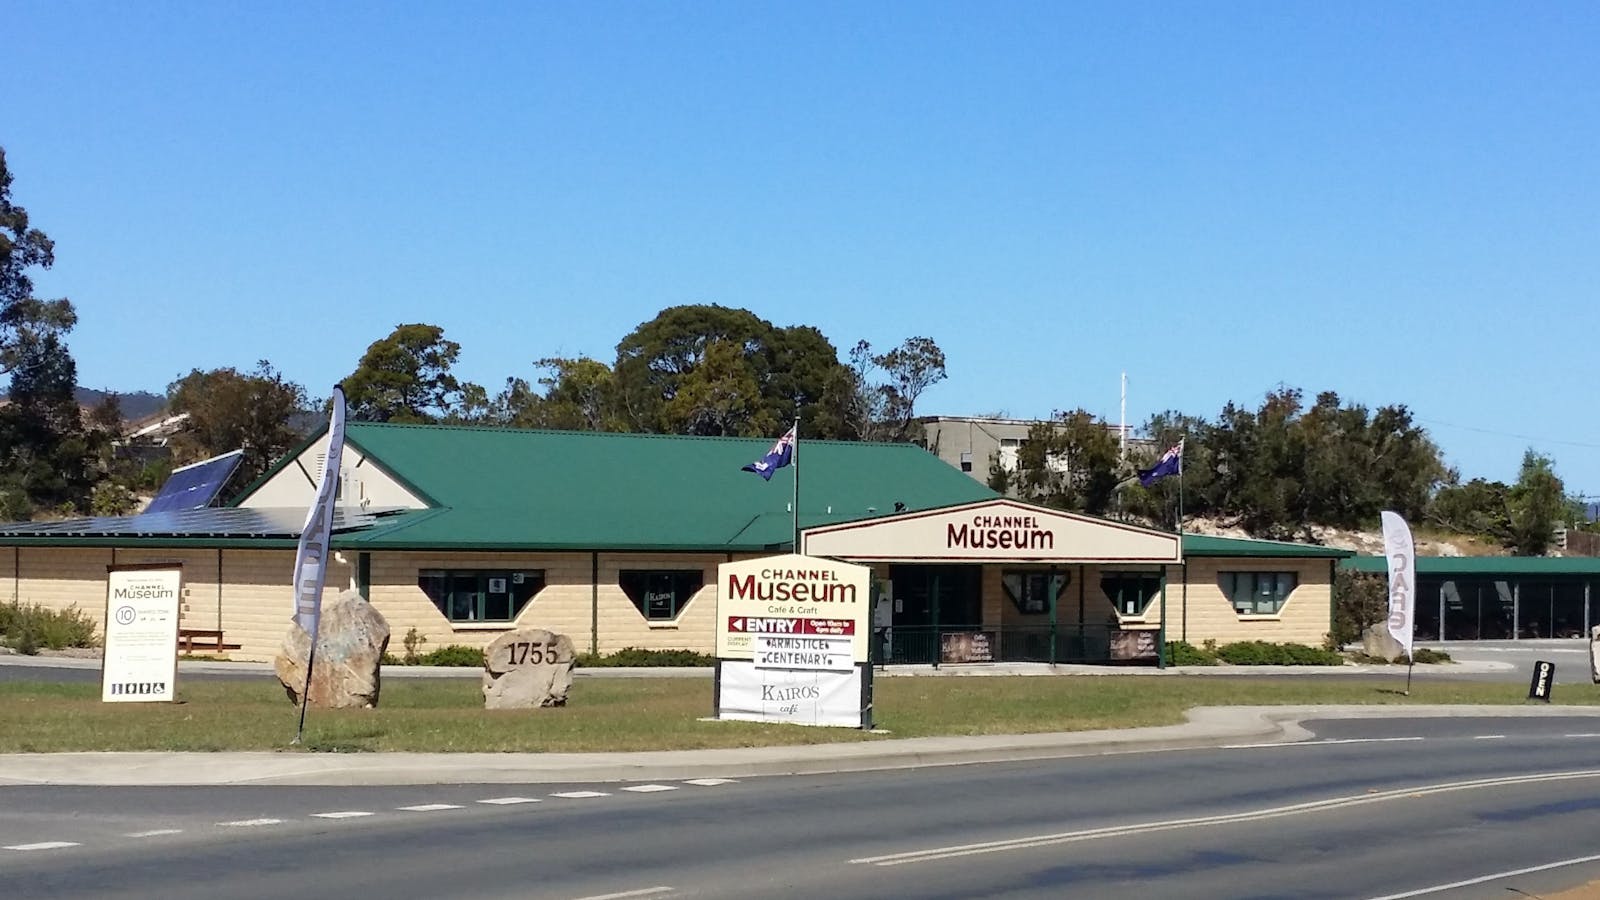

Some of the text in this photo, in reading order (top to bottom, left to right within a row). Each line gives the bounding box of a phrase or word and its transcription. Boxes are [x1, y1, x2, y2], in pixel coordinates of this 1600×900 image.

[973, 516, 1039, 528] CHANNEL
[947, 523, 1053, 549] Museum
[761, 569, 839, 581] CHANNEL
[115, 588, 173, 599] Museum
[729, 574, 856, 602] Museum
[120, 610, 132, 621] 10
[797, 606, 818, 614] Craft
[746, 618, 798, 633] ENTRY
[771, 639, 825, 650] ARMISTICE
[507, 643, 558, 665] 1755
[766, 652, 828, 665] CENTENARY
[1536, 663, 1549, 696] OPEN
[761, 685, 819, 701] KAIROS
